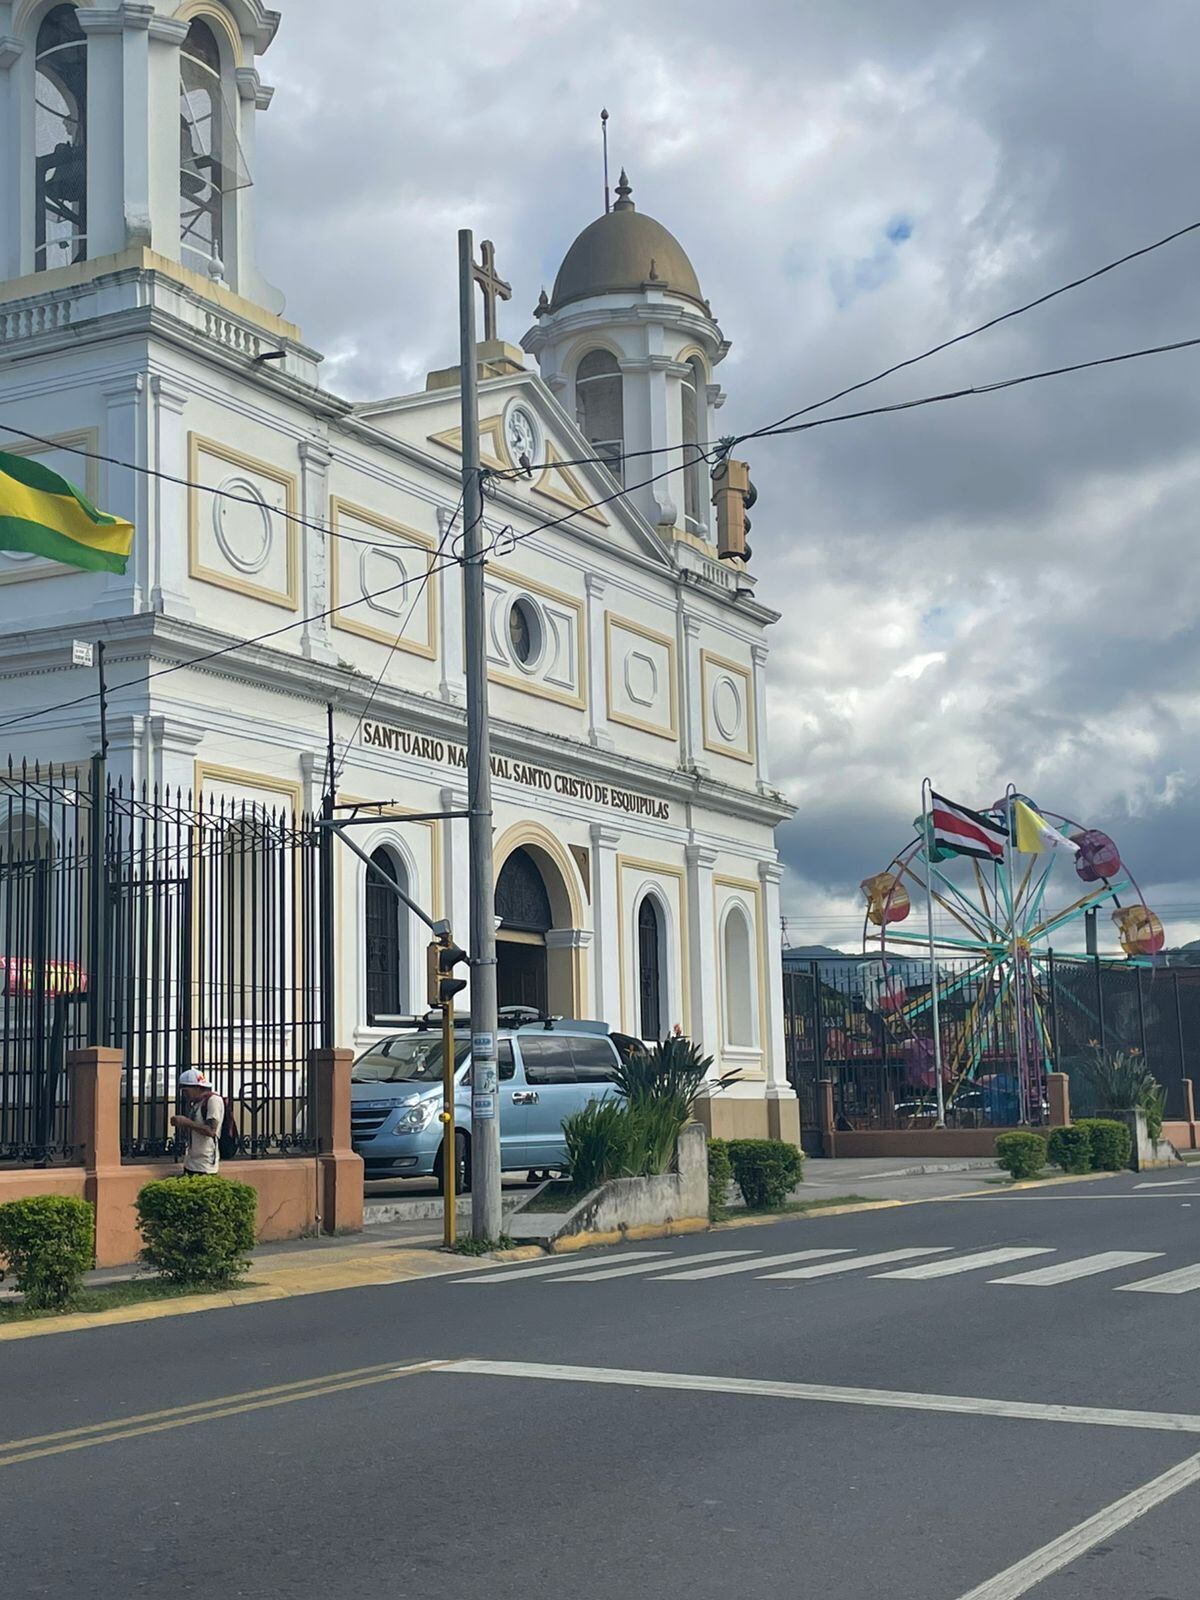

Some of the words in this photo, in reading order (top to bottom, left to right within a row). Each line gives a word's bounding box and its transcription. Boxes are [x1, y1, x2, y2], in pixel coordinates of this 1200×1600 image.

[364, 722, 444, 762] SANTUARIO
[447, 744, 512, 780] NANAL
[513, 763, 552, 790] SANTO
[554, 775, 593, 800] CRISTO
[594, 785, 609, 805] DE
[611, 788, 669, 820] ESQUIPULAS
